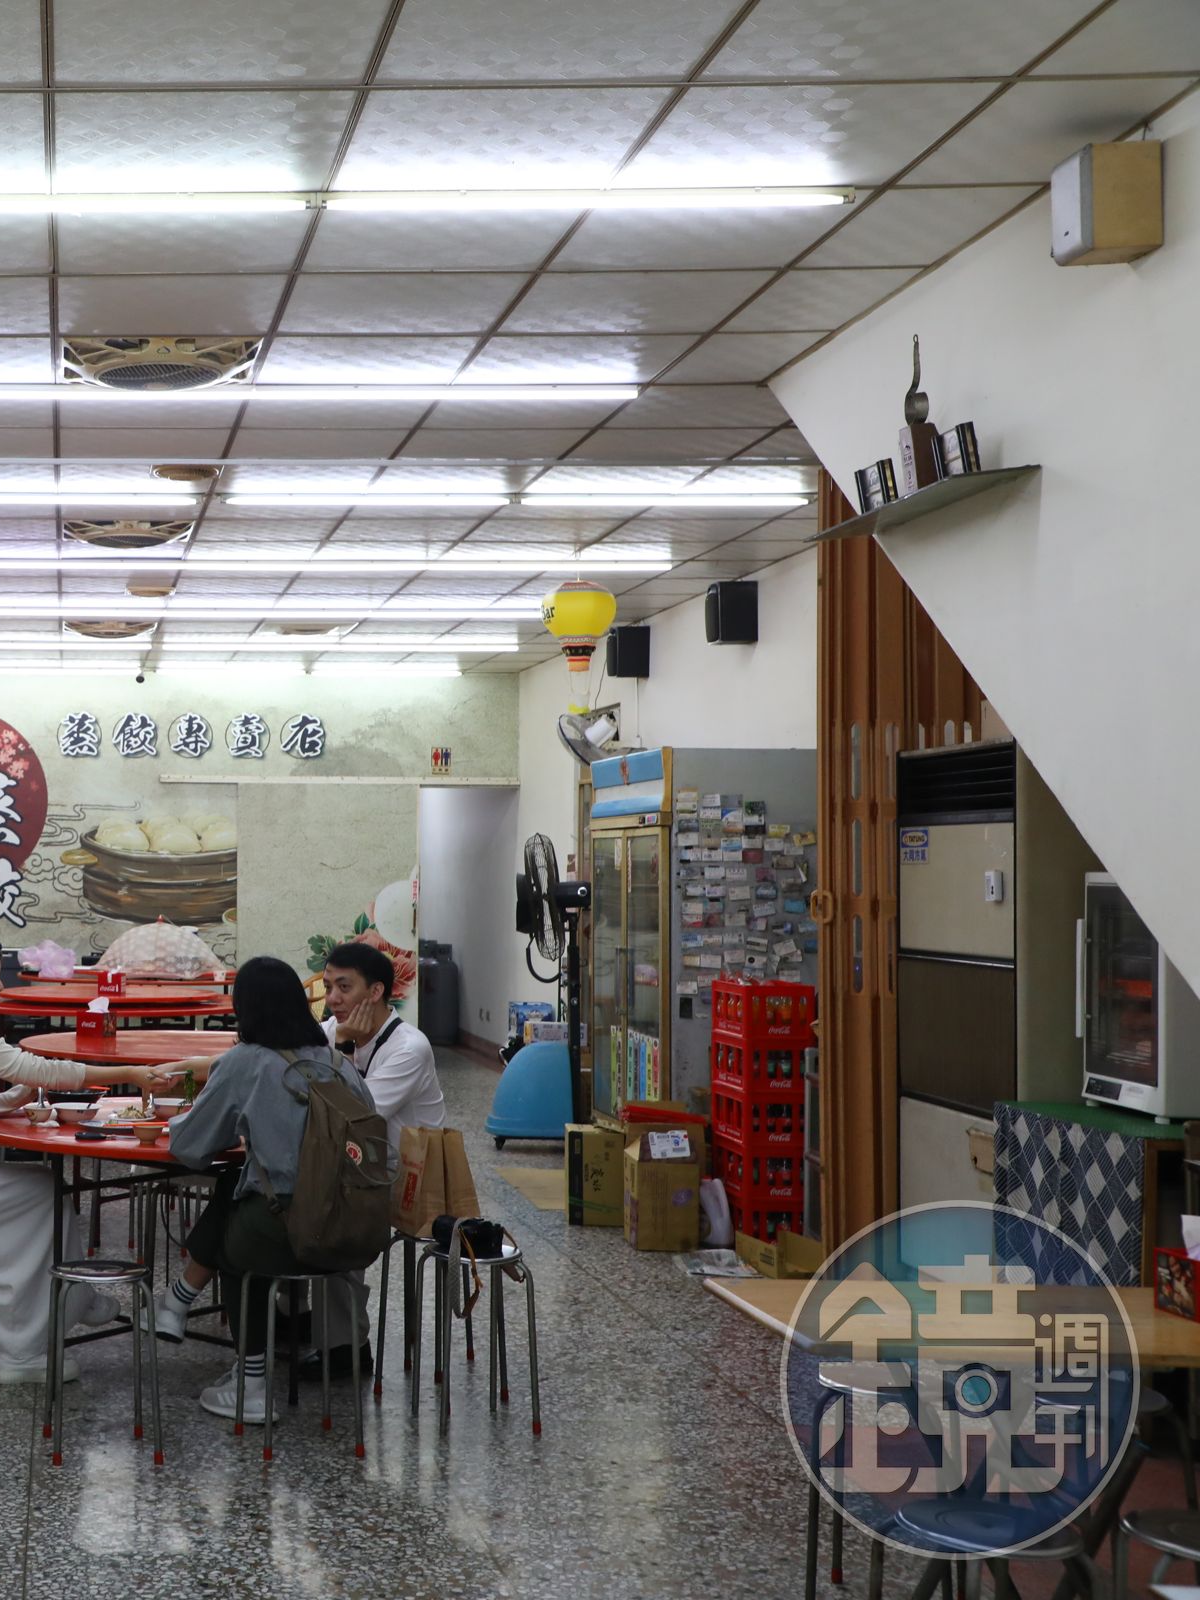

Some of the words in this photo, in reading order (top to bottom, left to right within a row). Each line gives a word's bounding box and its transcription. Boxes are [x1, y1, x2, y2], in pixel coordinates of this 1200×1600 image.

[58, 711, 324, 758] 蒸餃專賣店
